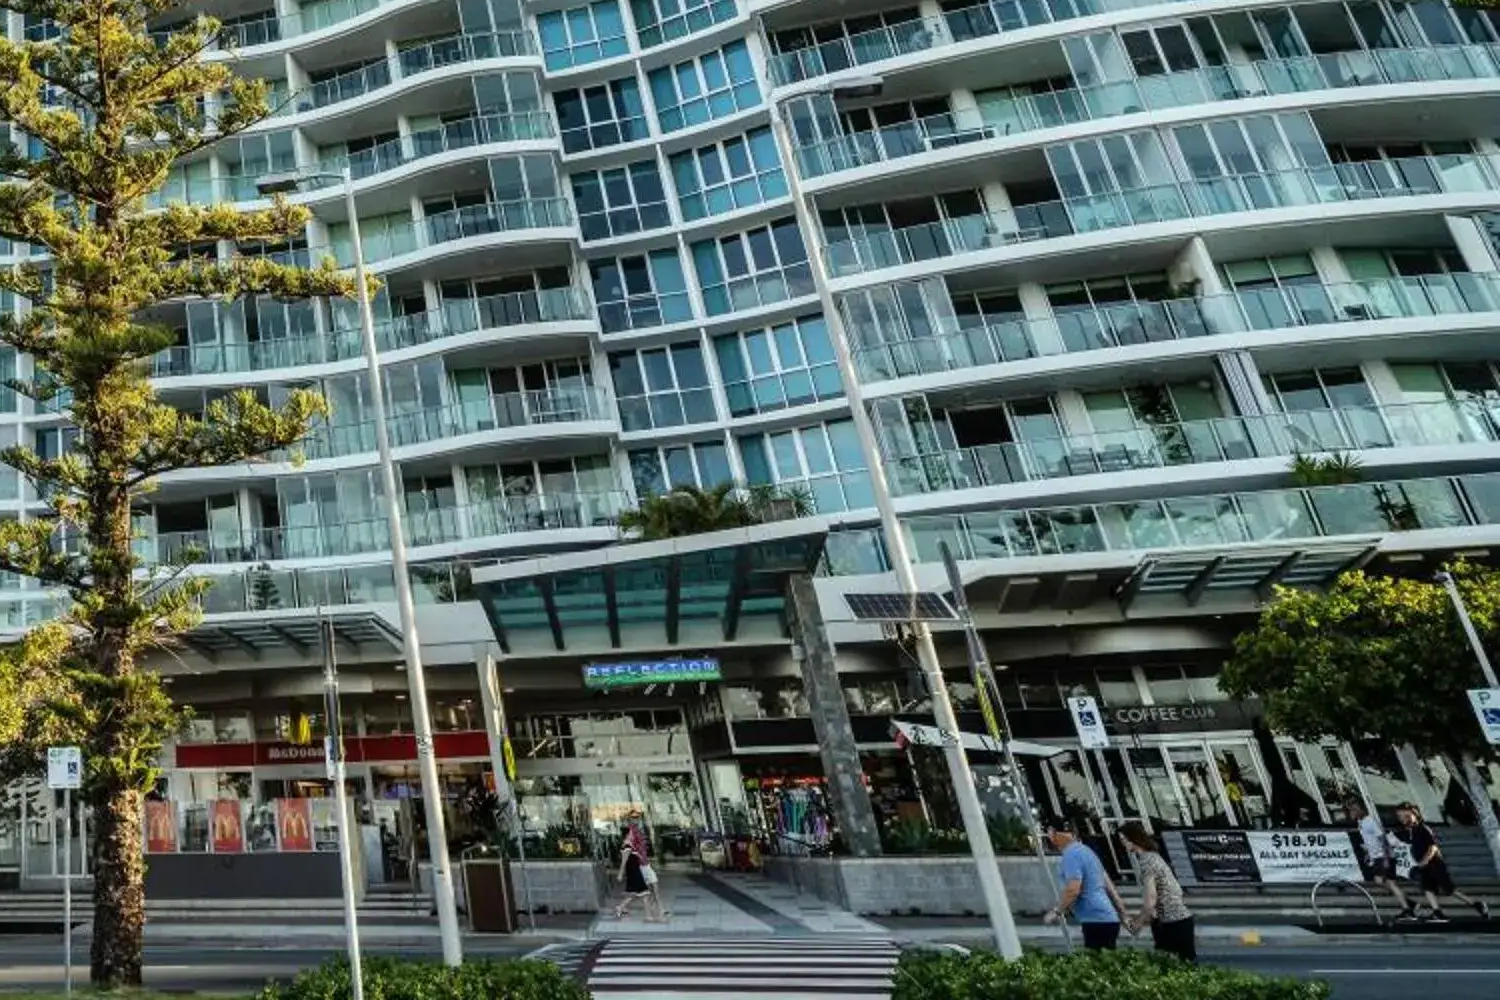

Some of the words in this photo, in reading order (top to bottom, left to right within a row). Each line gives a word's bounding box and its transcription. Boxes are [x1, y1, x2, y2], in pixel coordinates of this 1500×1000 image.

[1077, 699, 1088, 710] P
[1477, 691, 1491, 705] P
[1116, 707, 1181, 723] COFFEE
[1271, 833, 1327, 849] $18.90
[1260, 850, 1277, 859] ALL
[1279, 850, 1299, 860] DAY
[1301, 849, 1350, 859] SPECIALS
